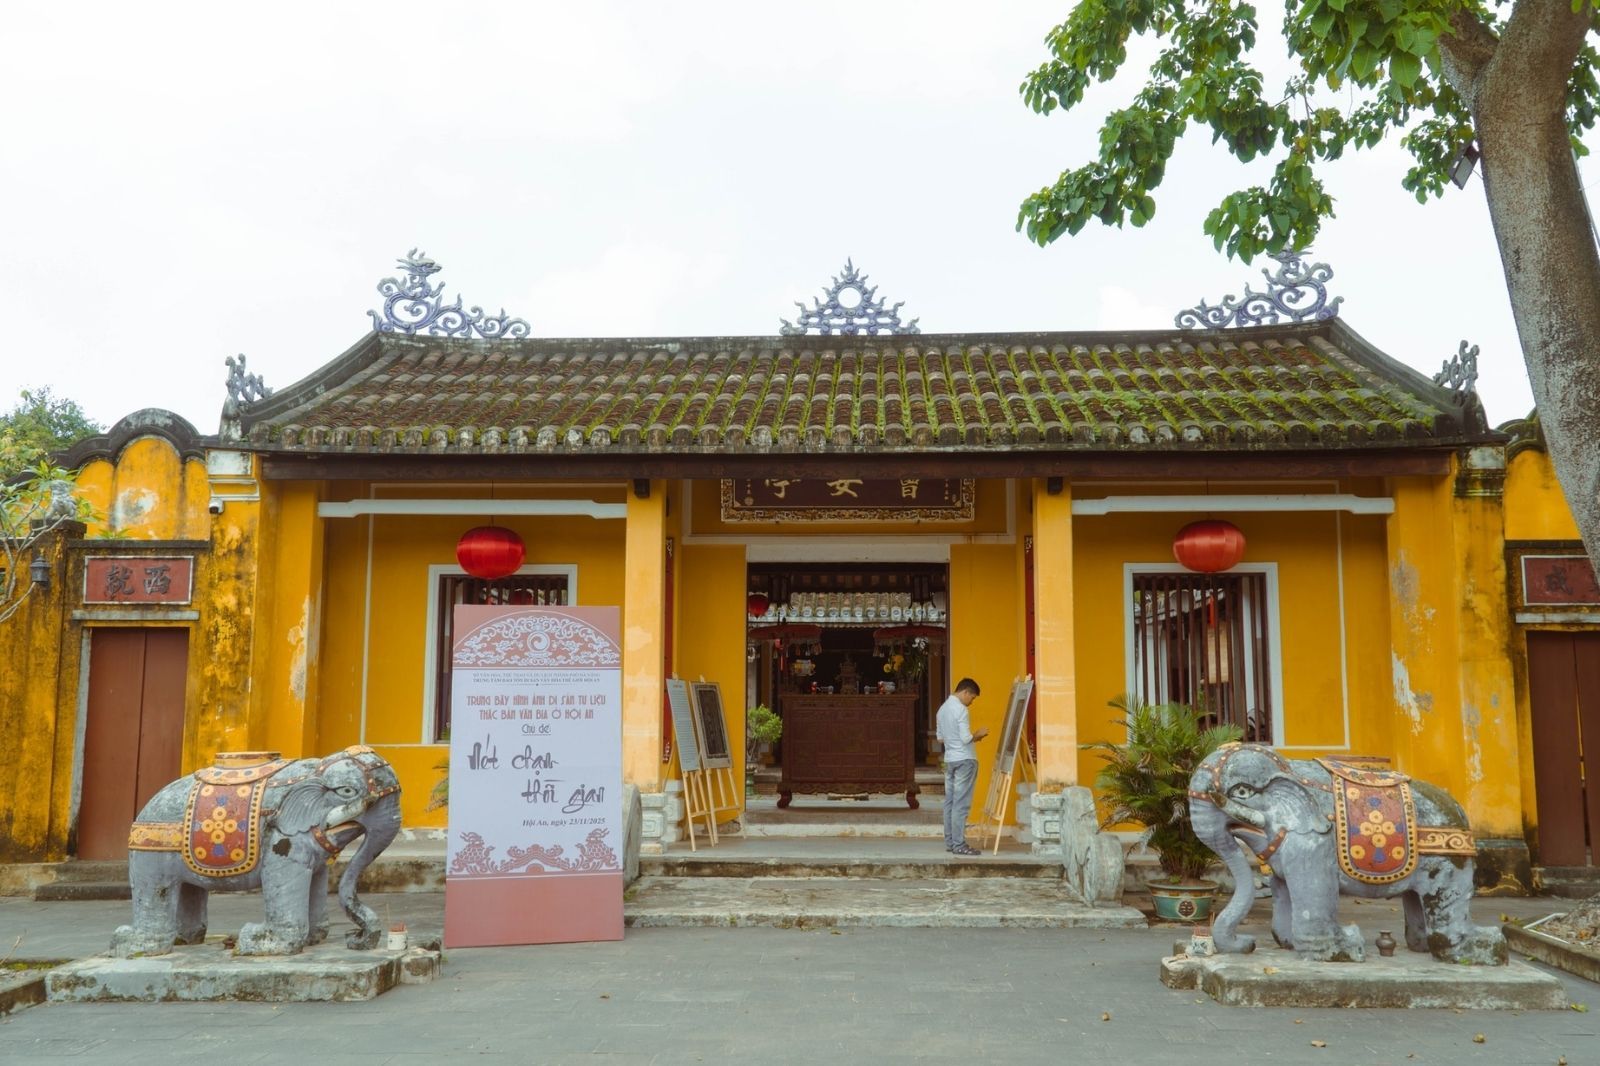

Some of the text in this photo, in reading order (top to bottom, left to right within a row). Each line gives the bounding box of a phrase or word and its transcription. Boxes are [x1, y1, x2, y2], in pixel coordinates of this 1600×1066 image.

[549, 695, 558, 706] DI
[536, 709, 548, 720] BIA
[585, 709, 594, 720] AN
